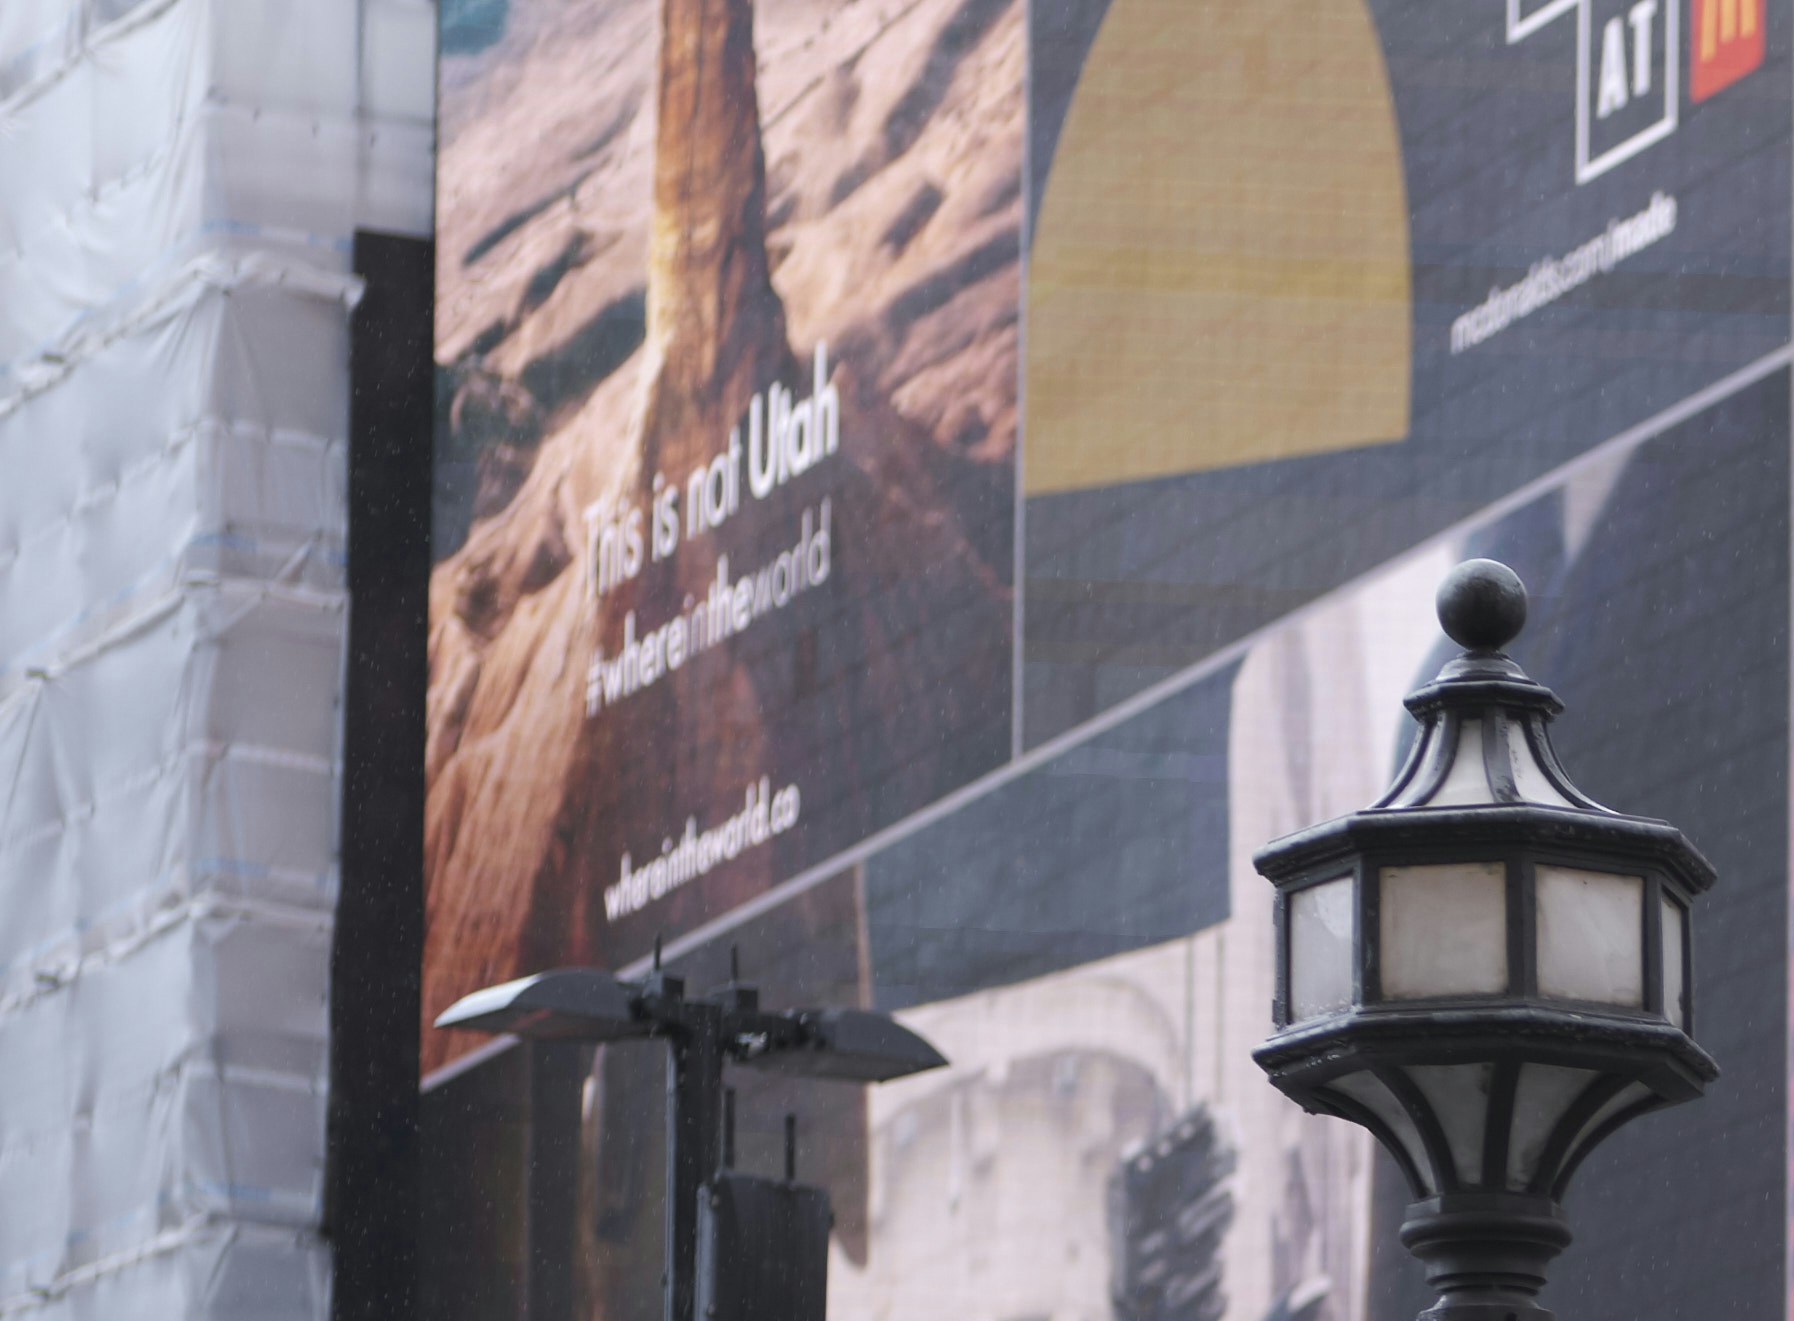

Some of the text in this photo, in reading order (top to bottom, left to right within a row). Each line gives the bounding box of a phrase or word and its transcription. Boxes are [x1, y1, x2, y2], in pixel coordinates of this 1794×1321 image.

[584, 338, 839, 600] This is not Utah
[586, 498, 831, 721] #whereintheworld
